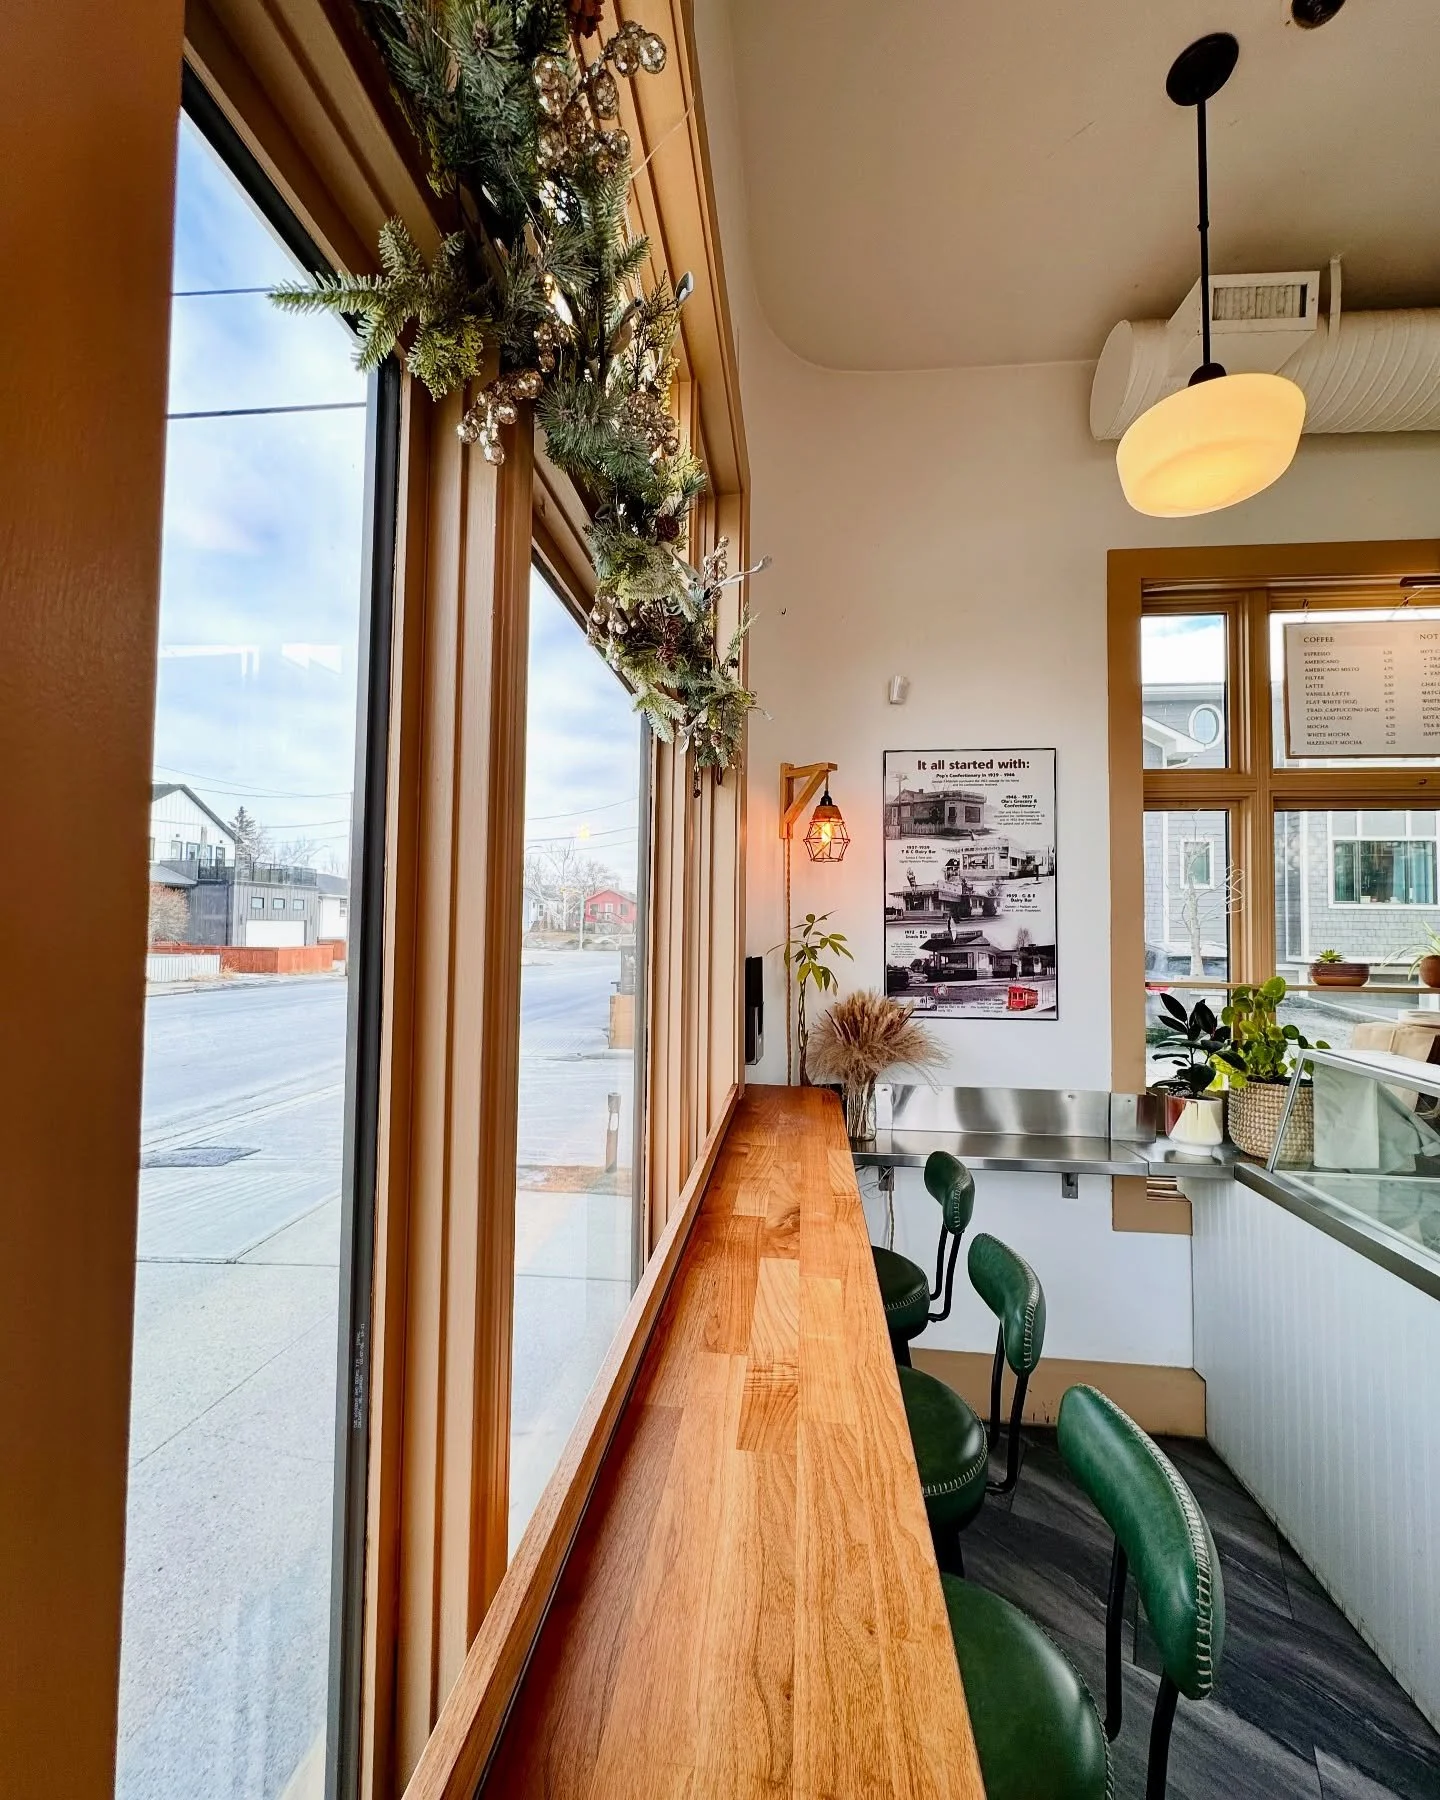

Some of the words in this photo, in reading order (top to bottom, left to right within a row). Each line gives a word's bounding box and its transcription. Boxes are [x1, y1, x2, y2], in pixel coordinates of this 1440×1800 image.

[918, 760, 927, 770] It
[930, 760, 945, 770] all
[949, 759, 994, 770] started
[998, 758, 1030, 769] with:
